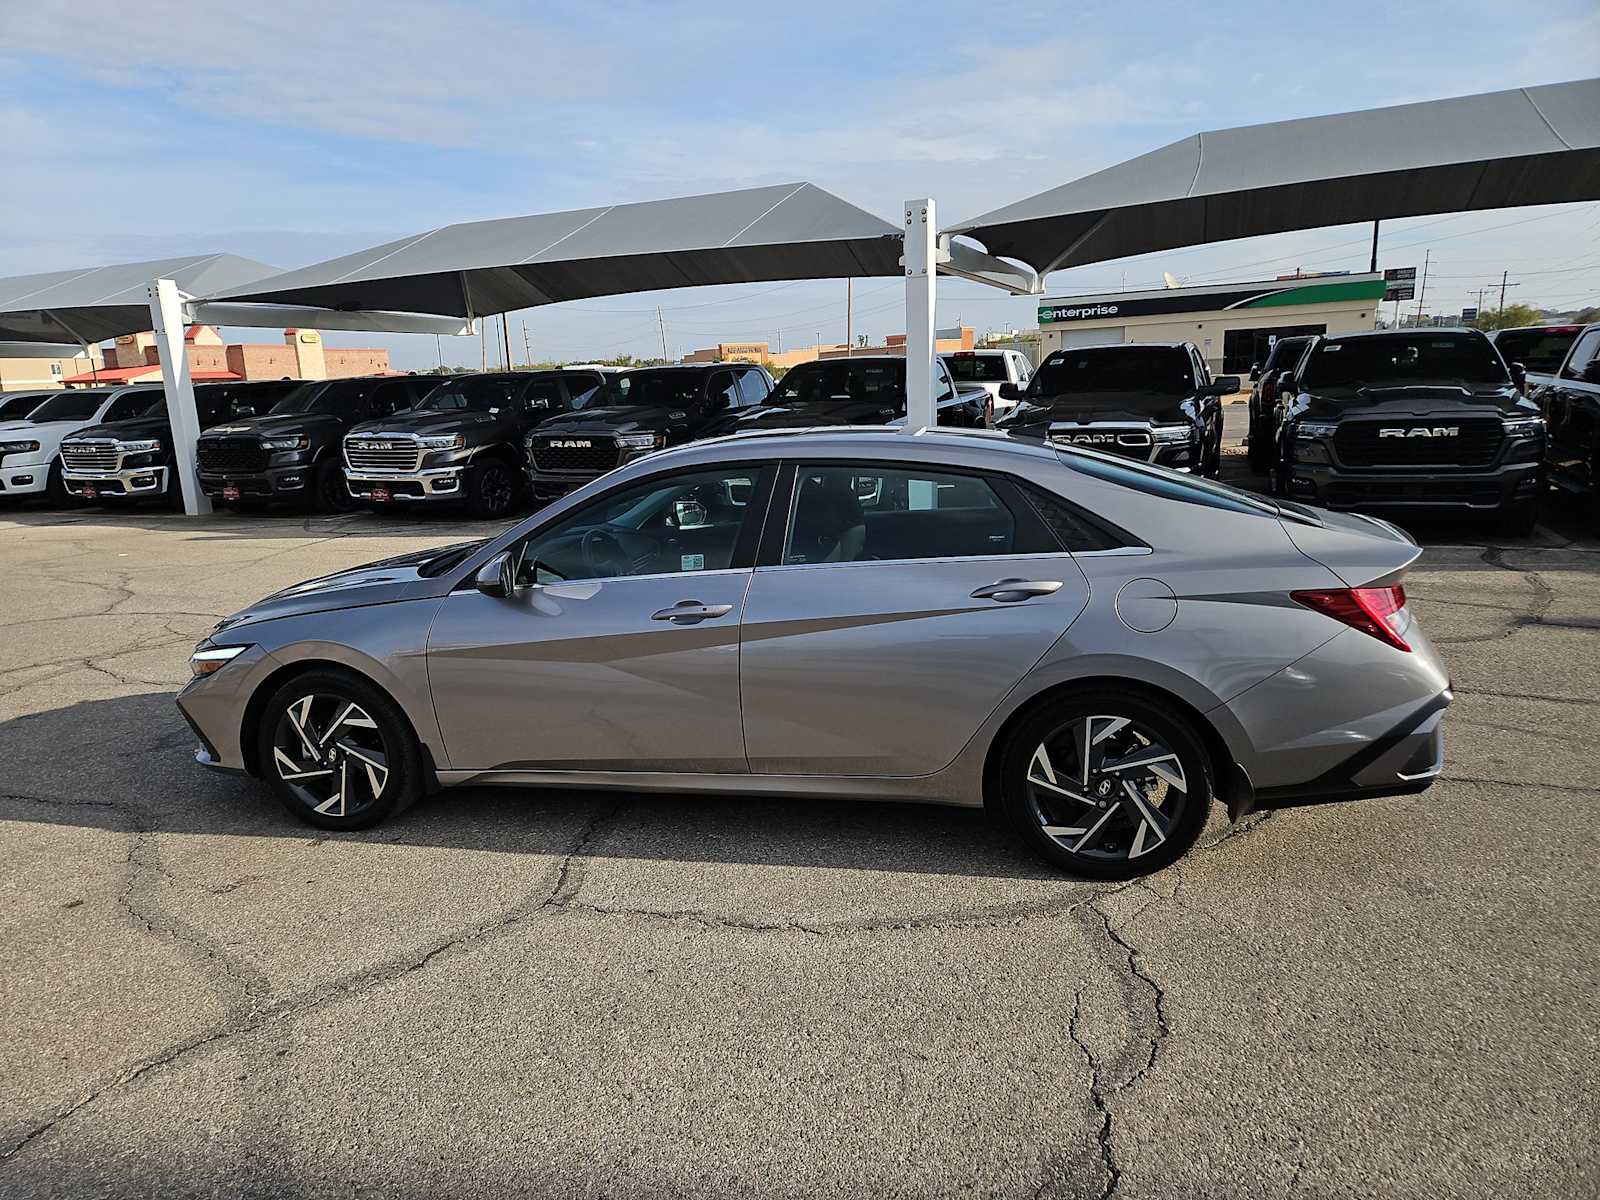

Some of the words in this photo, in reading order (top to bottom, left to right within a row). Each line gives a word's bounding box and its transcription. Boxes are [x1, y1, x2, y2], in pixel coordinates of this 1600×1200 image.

[1039, 305, 1118, 318] enterprise
[1379, 427, 1459, 438] RAM
[1052, 434, 1114, 443] RAM
[358, 441, 392, 449] RAM
[550, 440, 591, 448] RAM
